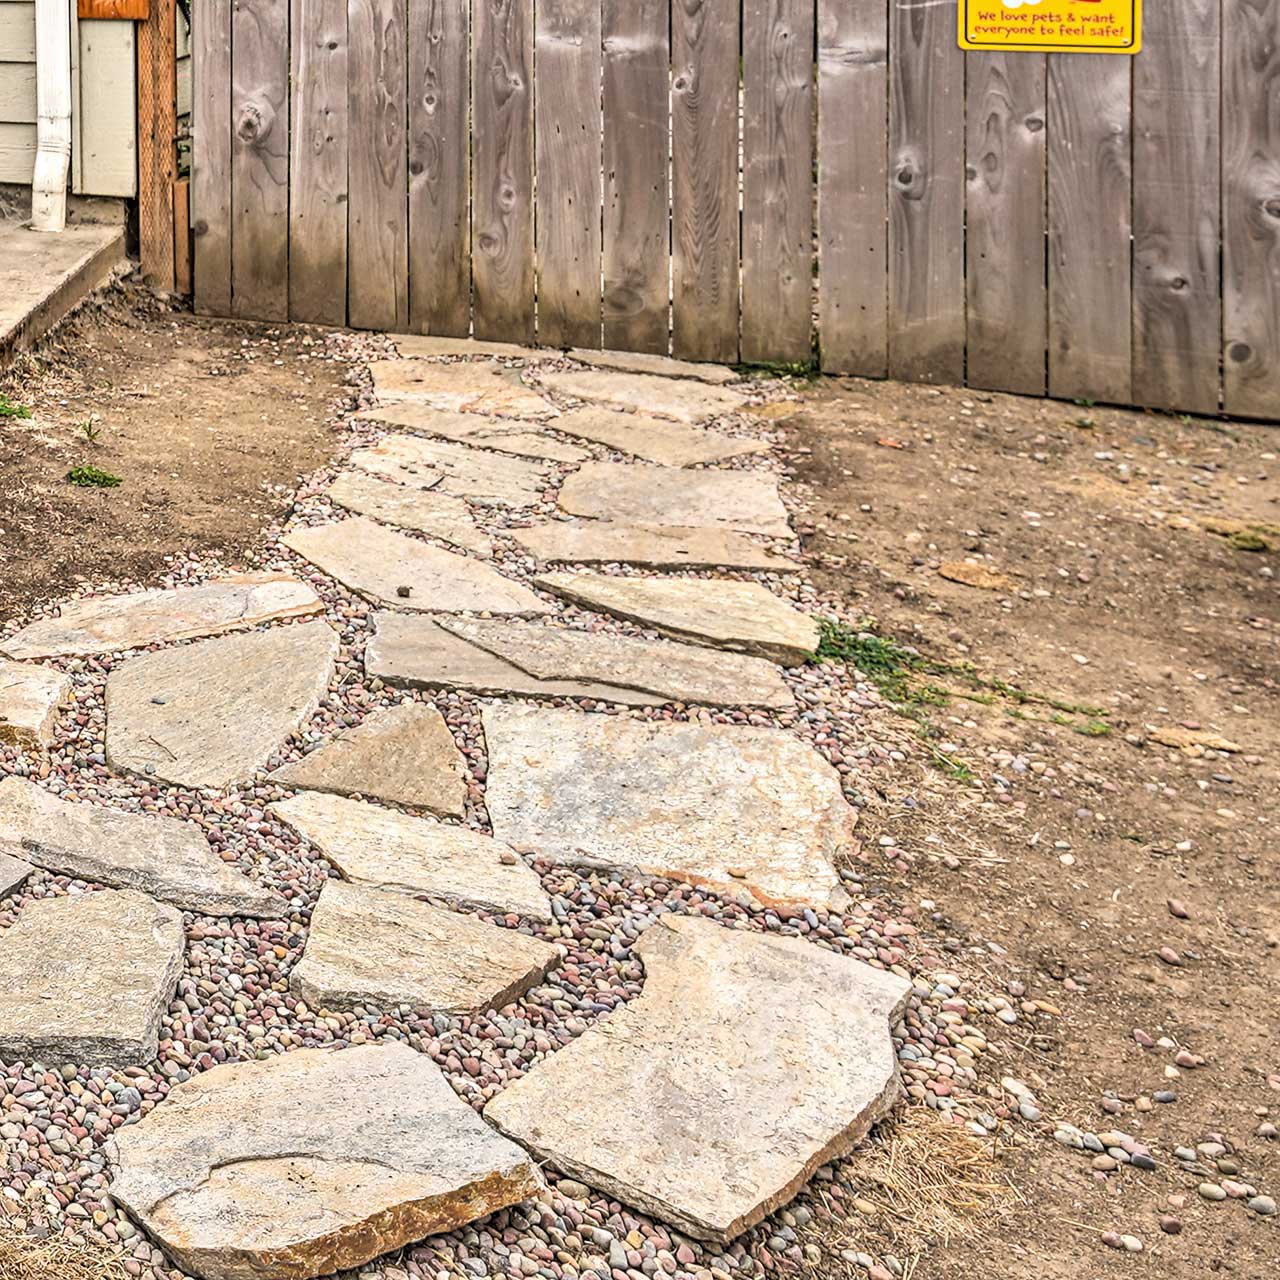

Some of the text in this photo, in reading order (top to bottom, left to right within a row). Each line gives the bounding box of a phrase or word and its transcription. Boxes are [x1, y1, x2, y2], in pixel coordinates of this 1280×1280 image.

[978, 10, 1115, 24] We love pets & want
[975, 25, 1124, 38] everyone to feel safe!
